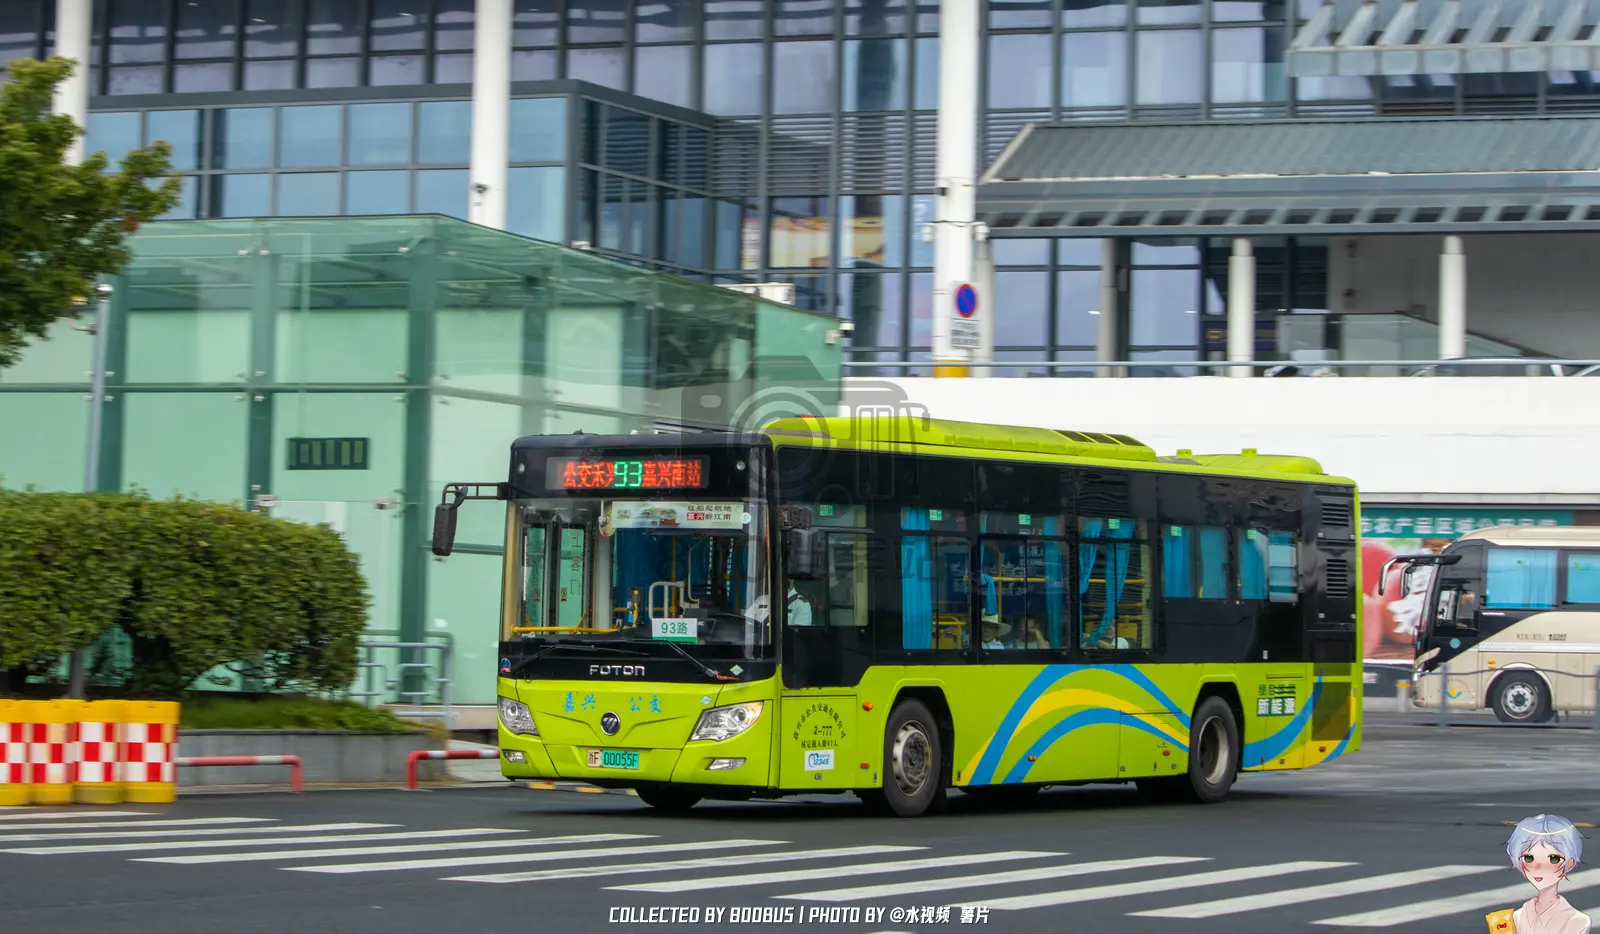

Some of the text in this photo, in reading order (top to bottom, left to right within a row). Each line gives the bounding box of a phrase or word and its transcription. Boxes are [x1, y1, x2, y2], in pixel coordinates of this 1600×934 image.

[614, 461, 642, 487] 93
[642, 460, 701, 487] 嘉兴南站
[661, 622, 688, 635] 93路
[589, 664, 645, 676] FOTON
[562, 691, 662, 714] 嘉兴 公交
[1257, 697, 1296, 716] 新能源
